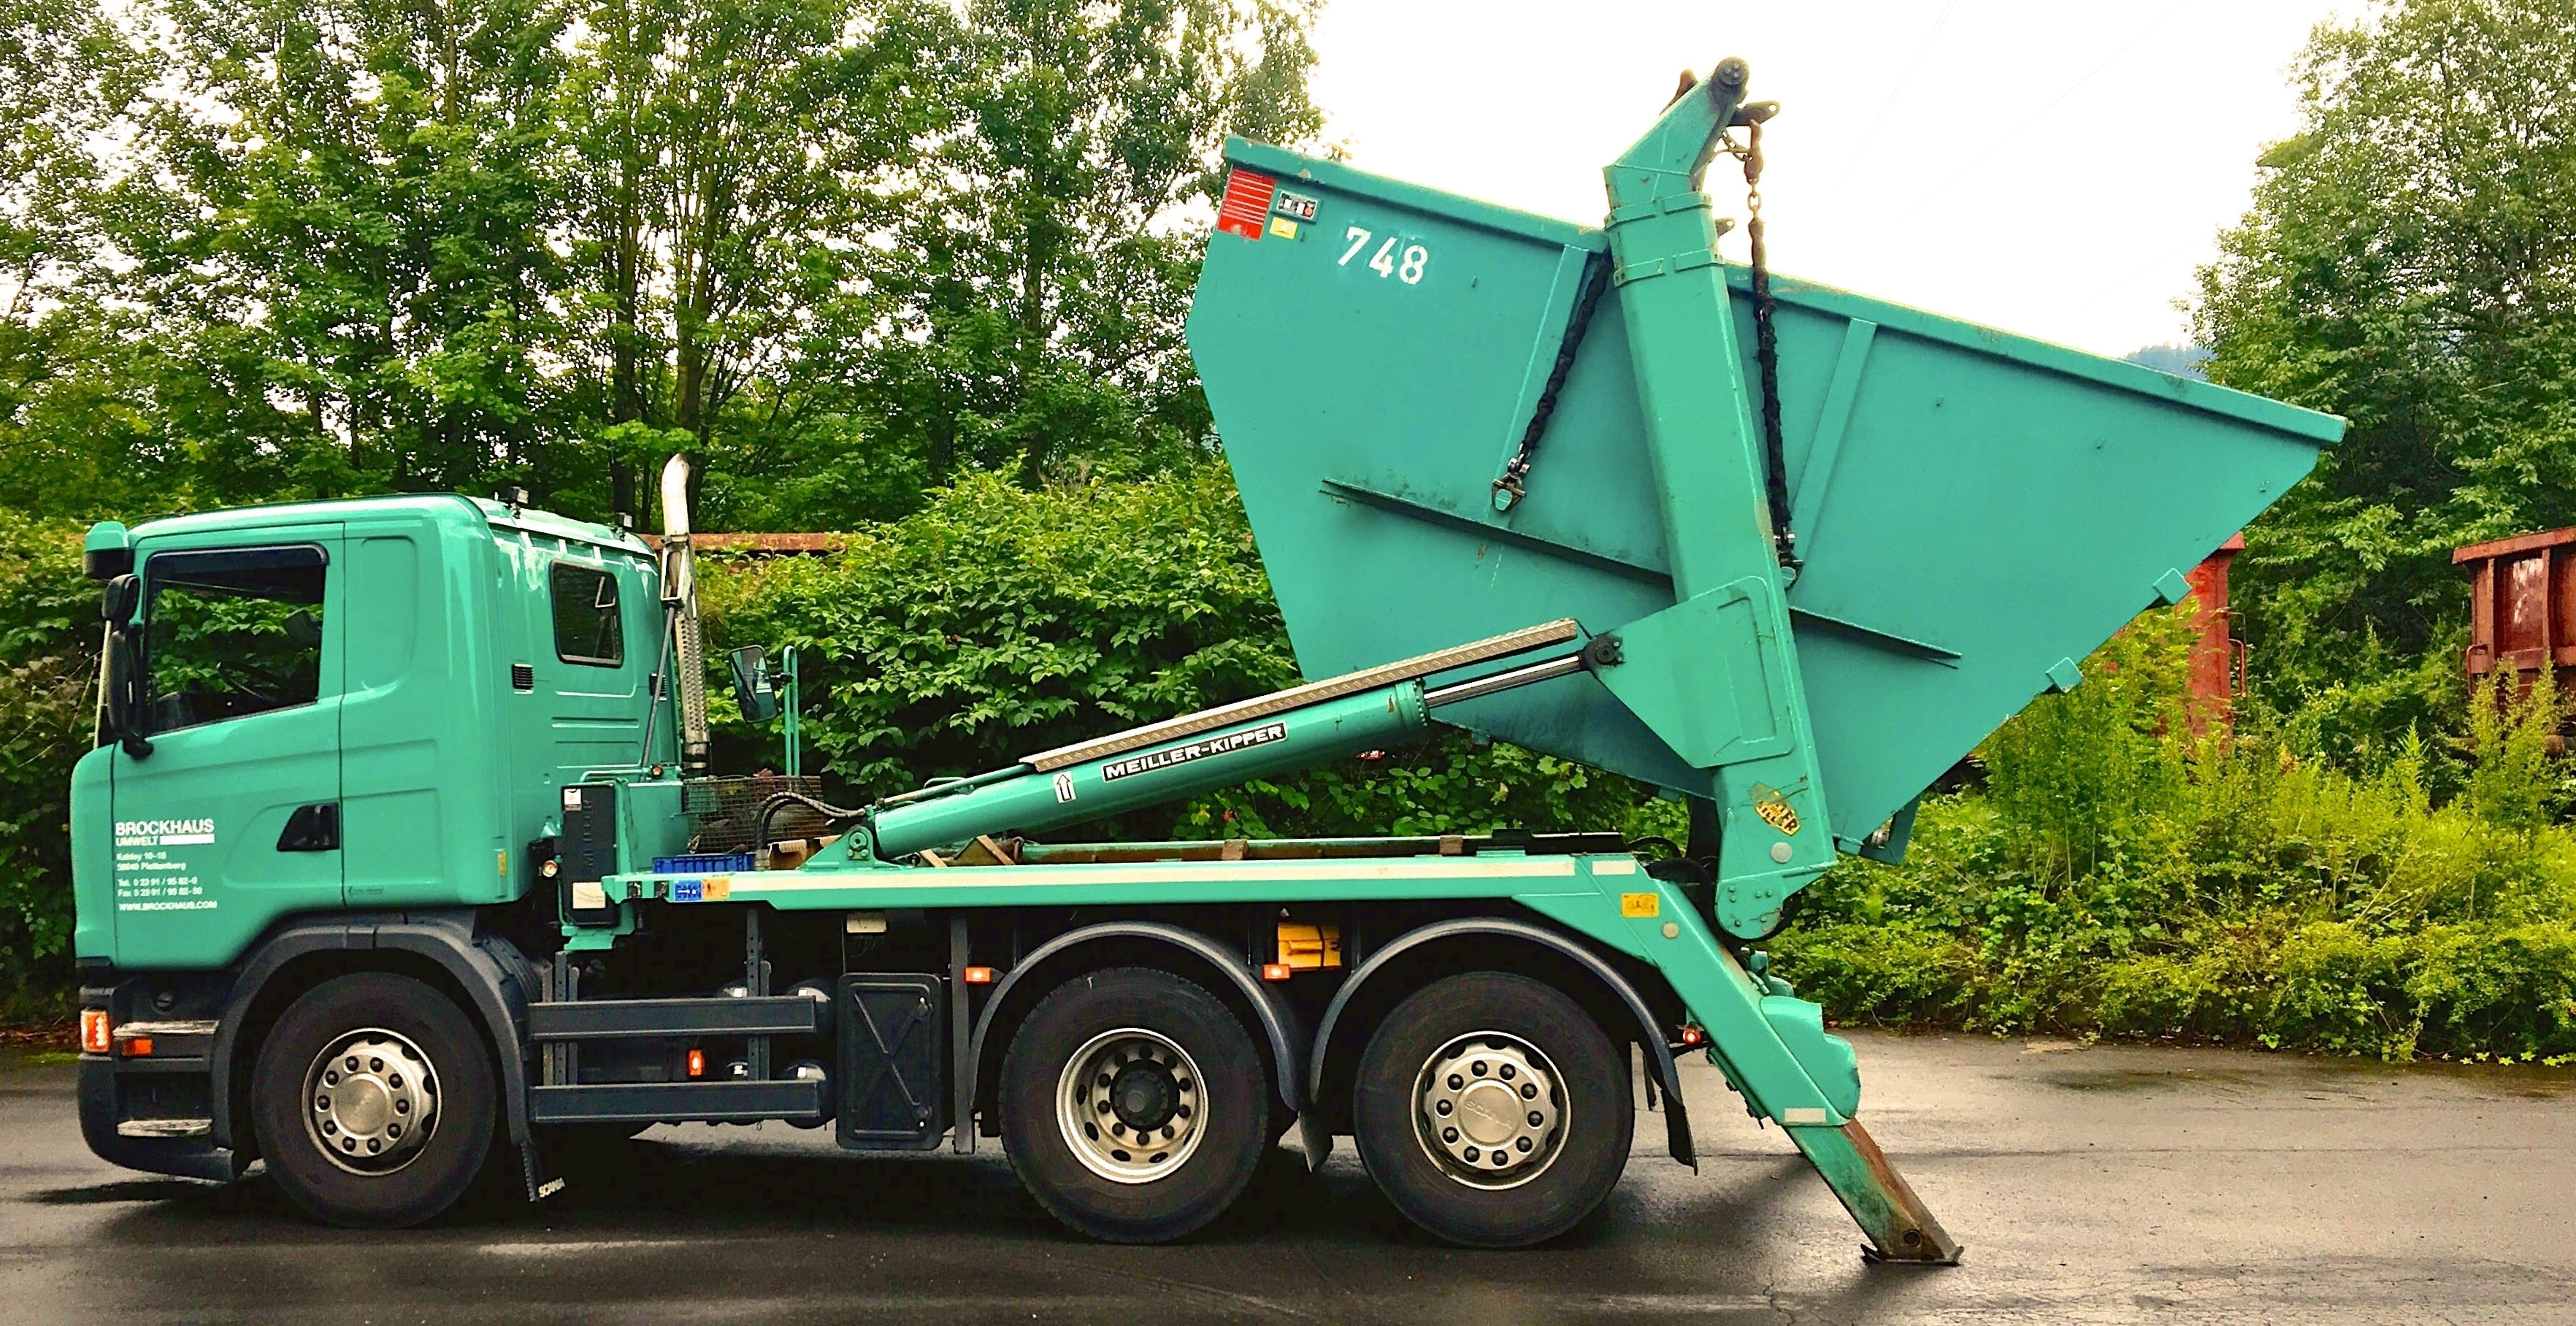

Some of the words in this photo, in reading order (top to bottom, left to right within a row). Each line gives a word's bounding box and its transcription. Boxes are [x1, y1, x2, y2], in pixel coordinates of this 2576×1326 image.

[1337, 226, 1429, 285] 748
[1106, 725, 1283, 779] MEILLER-KIPPER
[115, 818, 215, 837] BROCKHAUS
[115, 836, 158, 847] UMWELT
[118, 889, 131, 897] Fax
[119, 900, 218, 911] WWW.BROCKHAUS.COM
